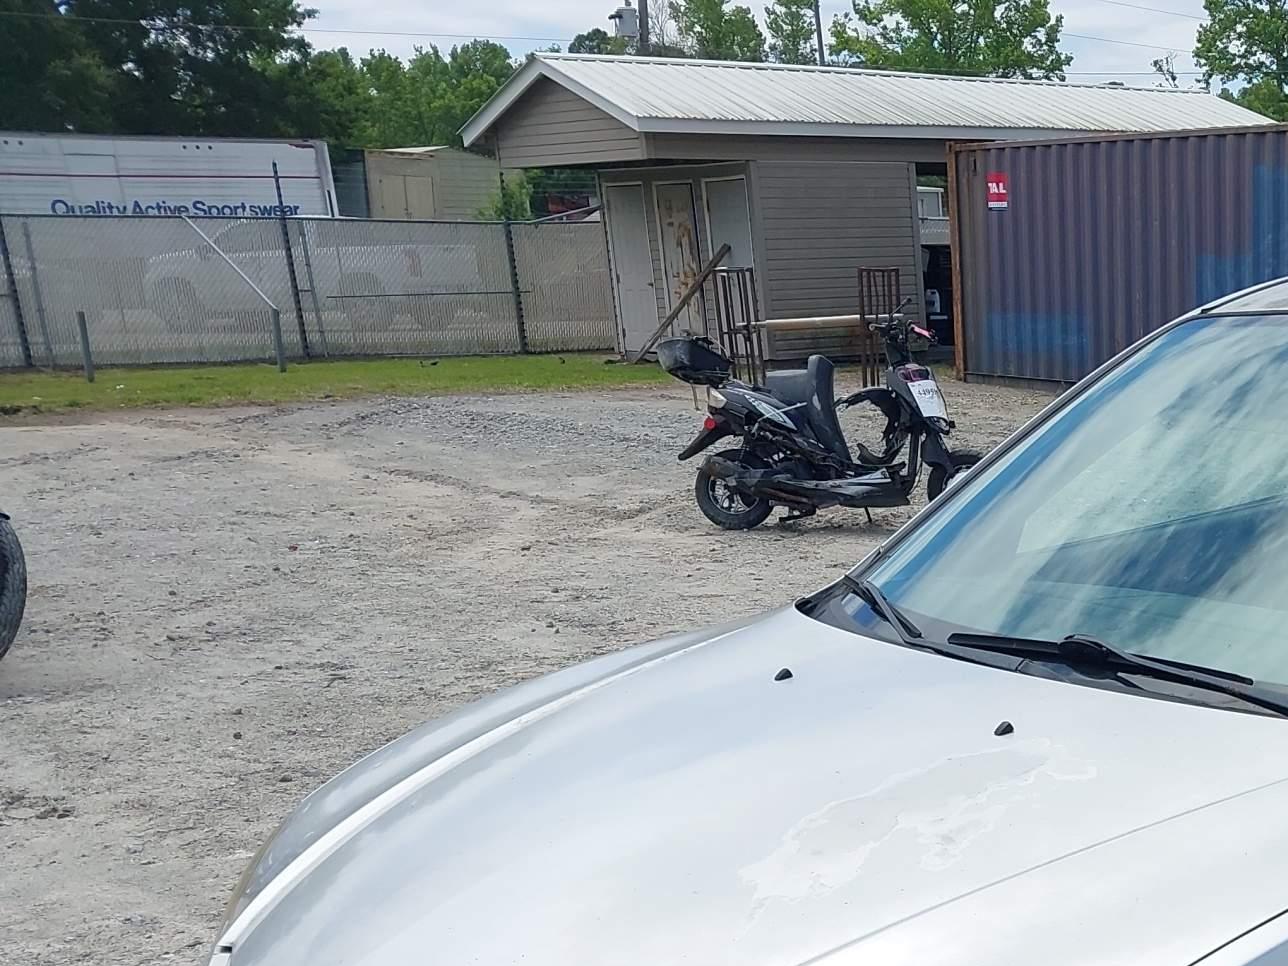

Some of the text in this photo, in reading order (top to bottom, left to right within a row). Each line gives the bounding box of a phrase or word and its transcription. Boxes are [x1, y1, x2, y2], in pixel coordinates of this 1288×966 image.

[987, 182, 1008, 194] TAL
[50, 199, 127, 215] Quality
[132, 199, 190, 215] Active
